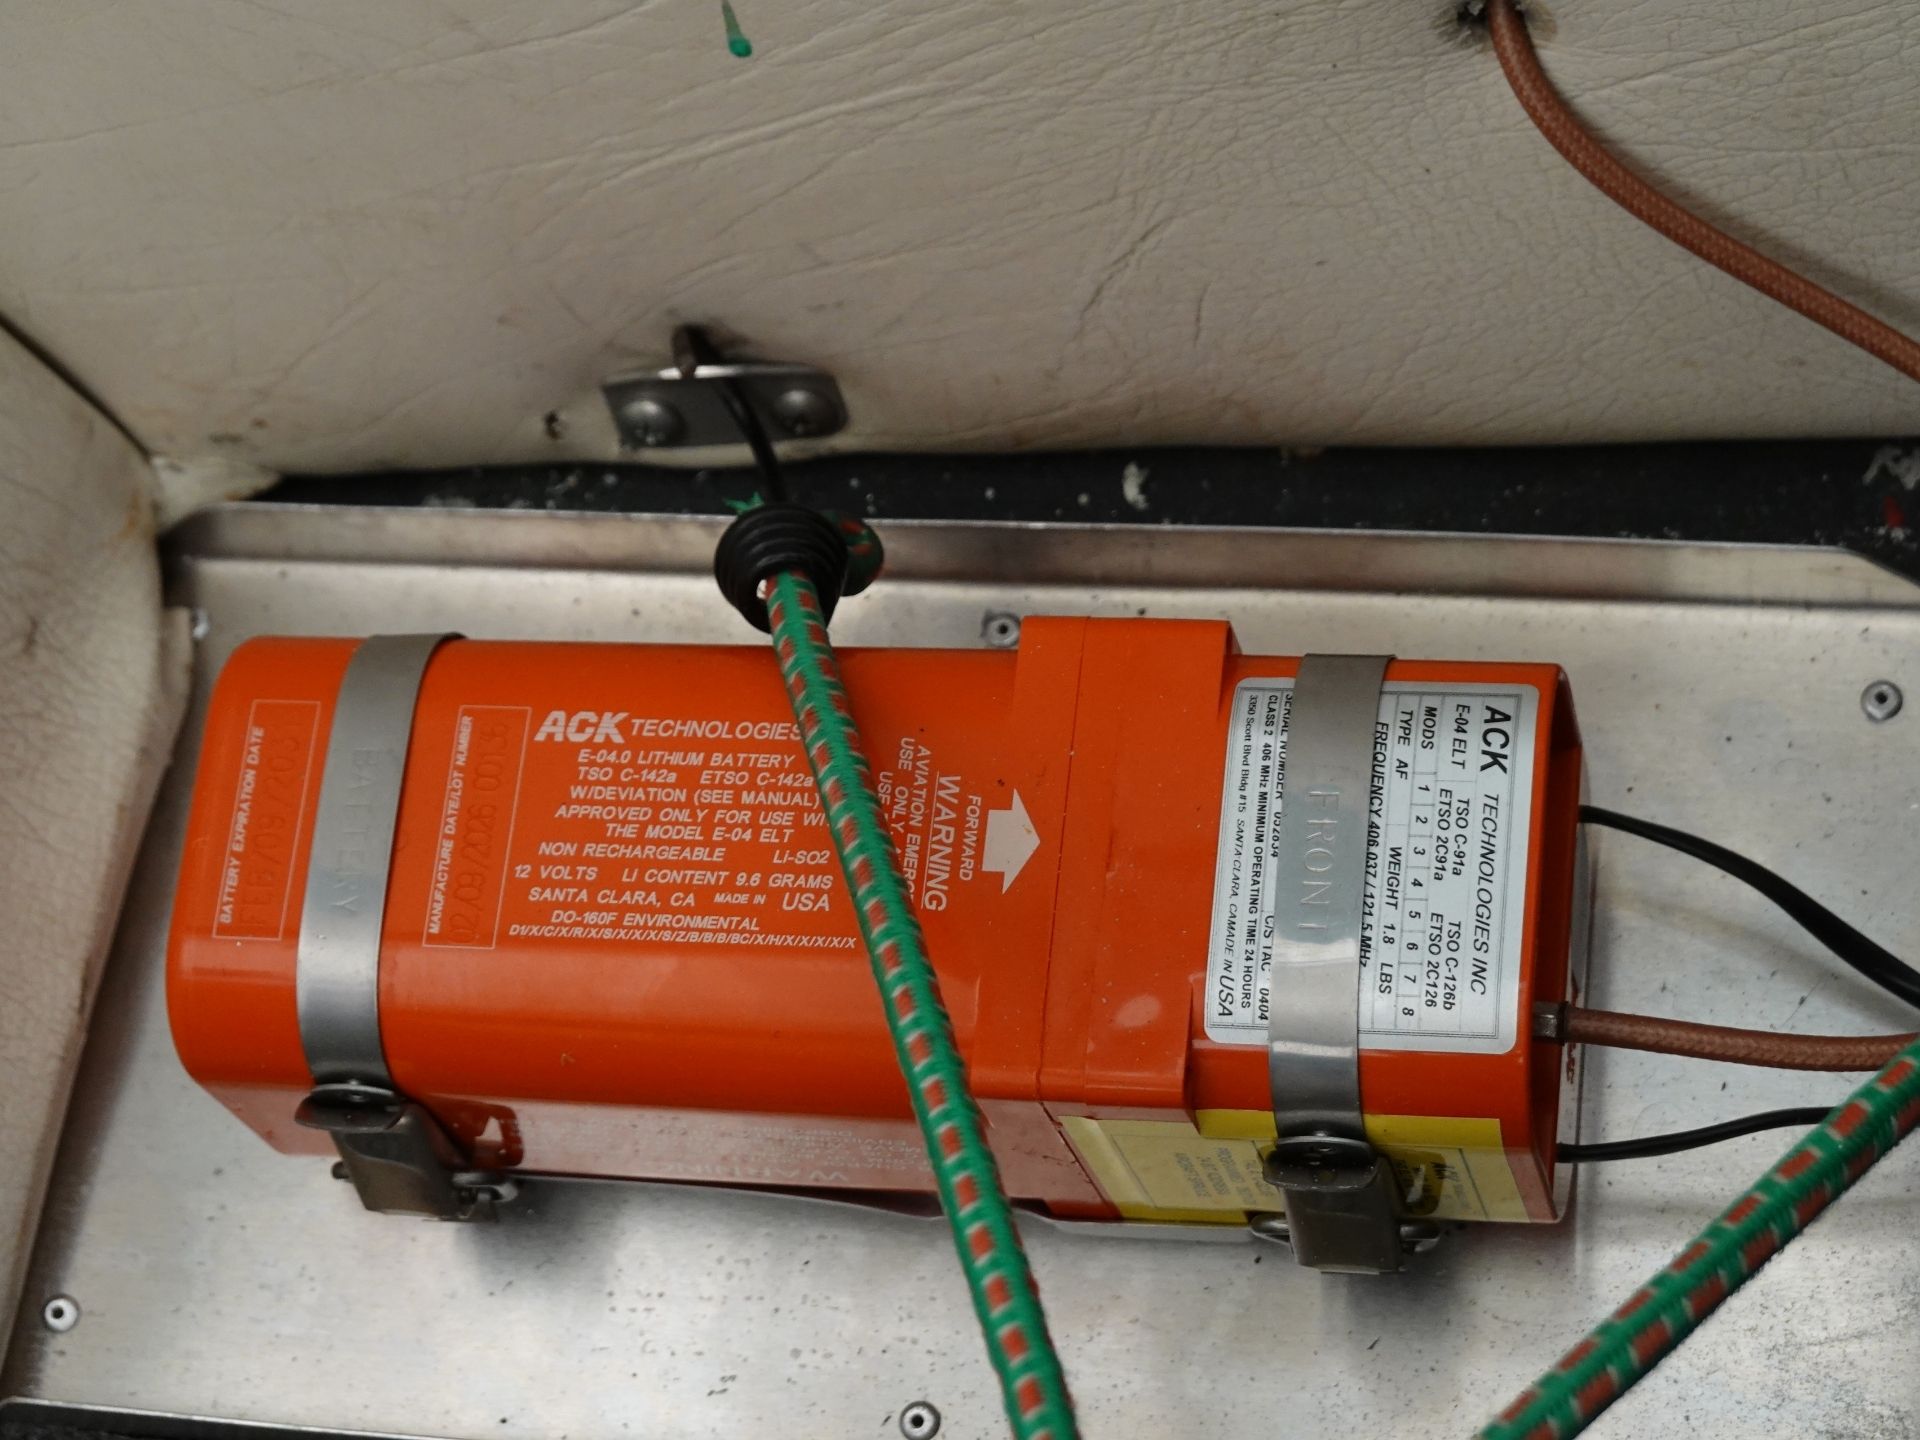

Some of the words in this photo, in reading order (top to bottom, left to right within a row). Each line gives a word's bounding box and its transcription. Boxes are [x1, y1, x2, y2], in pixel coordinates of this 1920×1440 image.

[1248, 695, 1258, 715] 3350
[1265, 695, 1278, 727] CLASS
[1455, 704, 1470, 733] E-04
[534, 711, 629, 744] ACK
[630, 718, 802, 741] TECHNOLOGIES
[1244, 718, 1254, 741] Scott
[1397, 709, 1413, 747] TYPE
[1421, 706, 1437, 749] MODS
[1480, 705, 1511, 774] ACK
[578, 750, 631, 764] E-04.0
[637, 750, 702, 766] LITHIUM
[710, 753, 795, 768] BATTERY
[898, 738, 914, 771] USE
[1242, 745, 1251, 765] Blvd
[1262, 743, 1272, 761] 406
[1452, 738, 1467, 769] ELT
[578, 767, 612, 780] TSO
[620, 768, 676, 783] C-142a
[700, 771, 749, 785] ETSO
[757, 773, 813, 787] C-142a
[1239, 770, 1249, 791] Bldg
[1260, 765, 1270, 787] MHz
[1370, 722, 1388, 819] FREQUENCY
[1395, 758, 1409, 780] AF
[570, 786, 686, 802] W/DEVIATION
[693, 789, 733, 806] (SEE
[741, 792, 821, 808] MANUAL)
[878, 772, 892, 804] USE
[909, 745, 931, 826] AVIATION
[429, 840, 454, 934] MANUFACTURE
[444, 771, 464, 834] DATE/LOT
[455, 716, 472, 766] NUMBER
[555, 805, 652, 821] APPROVED
[659, 808, 708, 823] ONLY
[715, 810, 751, 824] FOR
[759, 811, 795, 825] USE
[803, 813, 831, 827] WI
[1255, 792, 1268, 842] MINIMUM
[1416, 816, 1428, 824] 2
[1438, 788, 1452, 830] ETSO
[1456, 798, 1470, 829] TSO
[219, 857, 241, 924] BATTERY
[232, 768, 256, 851] EXPIRATION
[246, 727, 264, 765] DATE
[605, 824, 639, 837] THE
[645, 825, 702, 840] MODEL
[712, 827, 753, 841] E-04
[760, 828, 794, 843] ELT
[959, 795, 981, 881] FORWARD
[1234, 819, 1245, 855] SANTA
[539, 842, 577, 856] NON
[582, 843, 725, 862] RECHARGEABLE
[924, 775, 961, 911] WARNING
[1366, 822, 1380, 878] 406.037
[1413, 847, 1425, 855] 3
[1434, 836, 1449, 881] 2C91a
[1452, 834, 1467, 875] C-91a
[514, 864, 531, 878] 12
[540, 865, 597, 880] VOLTS
[645, 869, 729, 886] CONTENT
[735, 872, 760, 886] 9.6
[768, 873, 833, 888] GRAMS
[903, 833, 920, 902] EMERG
[1249, 847, 1263, 914] OPERATING
[1386, 847, 1402, 909] WEIGHT
[1411, 878, 1423, 887] 4
[1474, 794, 1499, 953] TECHNOLOGIES
[528, 887, 591, 903] SANTA
[597, 889, 662, 907] CLARA,
[669, 892, 695, 906] CA
[714, 892, 749, 904] MADE
[753, 894, 765, 905] IN
[782, 892, 830, 912] USA
[1409, 911, 1421, 919] 5
[551, 909, 617, 926] DO-160F
[623, 912, 759, 931] ENVIRONMENTAL
[1246, 919, 1257, 945] TIME
[1383, 924, 1396, 944] 1.8
[1429, 913, 1443, 955] ETSO
[1360, 935, 1372, 967] MHz
[1447, 921, 1461, 952] TSO
[1224, 959, 1232, 973] IN
[1244, 950, 1254, 961] 24
[1241, 966, 1253, 1008] HOURS
[1378, 962, 1394, 995] LBS
[1404, 975, 1416, 983] 7
[1425, 960, 1439, 1007] 2C126
[1443, 958, 1458, 1010] C-126b
[1471, 958, 1487, 995] INC
[1218, 975, 1234, 1016] USA
[1258, 988, 1269, 1020] 0404
[1403, 1008, 1414, 1016] 8
